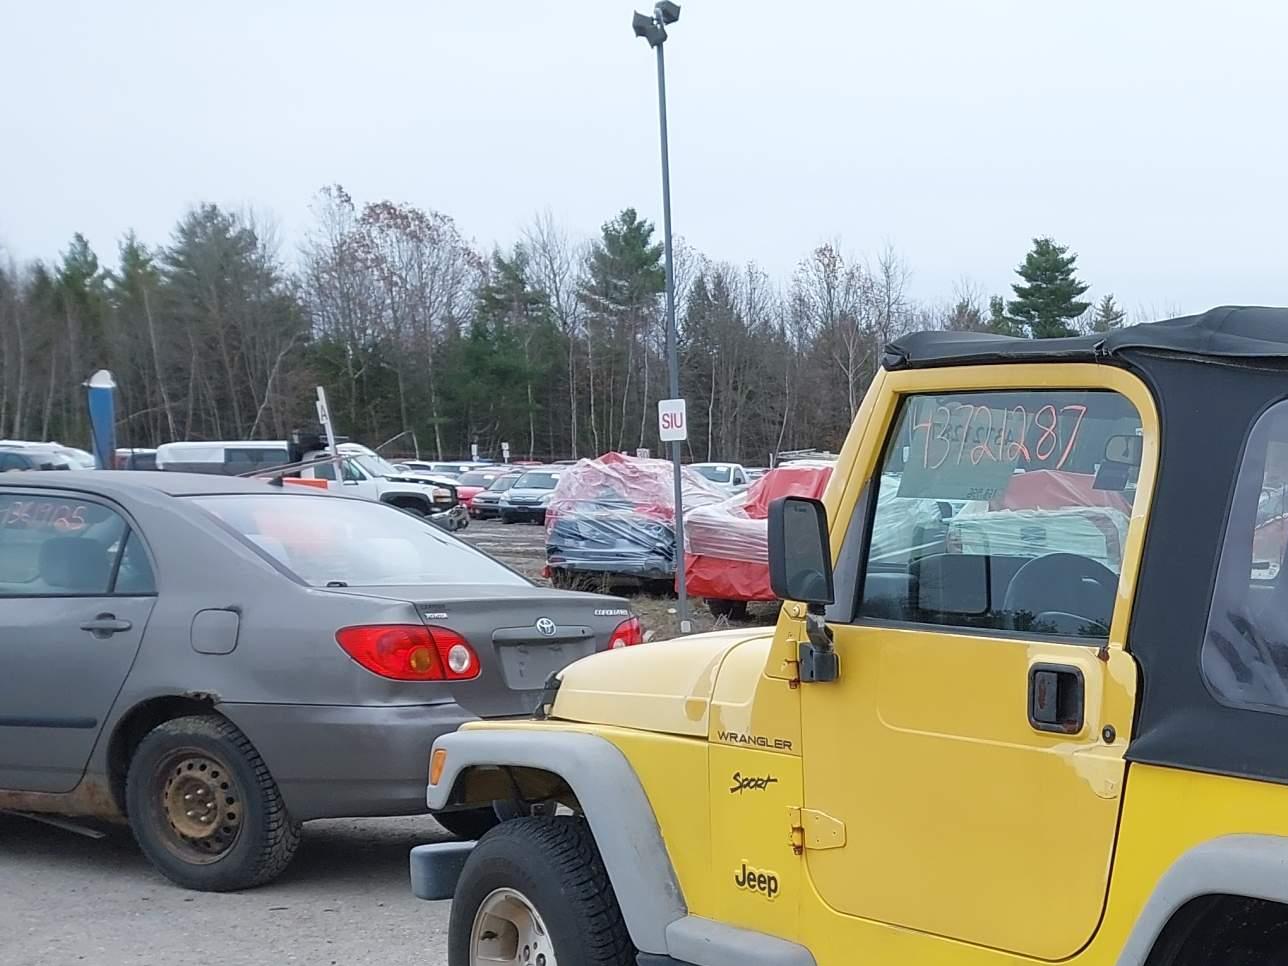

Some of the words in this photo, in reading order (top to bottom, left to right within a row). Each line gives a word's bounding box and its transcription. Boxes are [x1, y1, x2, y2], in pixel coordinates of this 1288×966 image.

[320, 404, 329, 421] A
[661, 412, 684, 429] SIU
[912, 404, 1088, 469] 43721287
[717, 730, 793, 751] WRANGLER
[735, 863, 778, 897] Jeep
